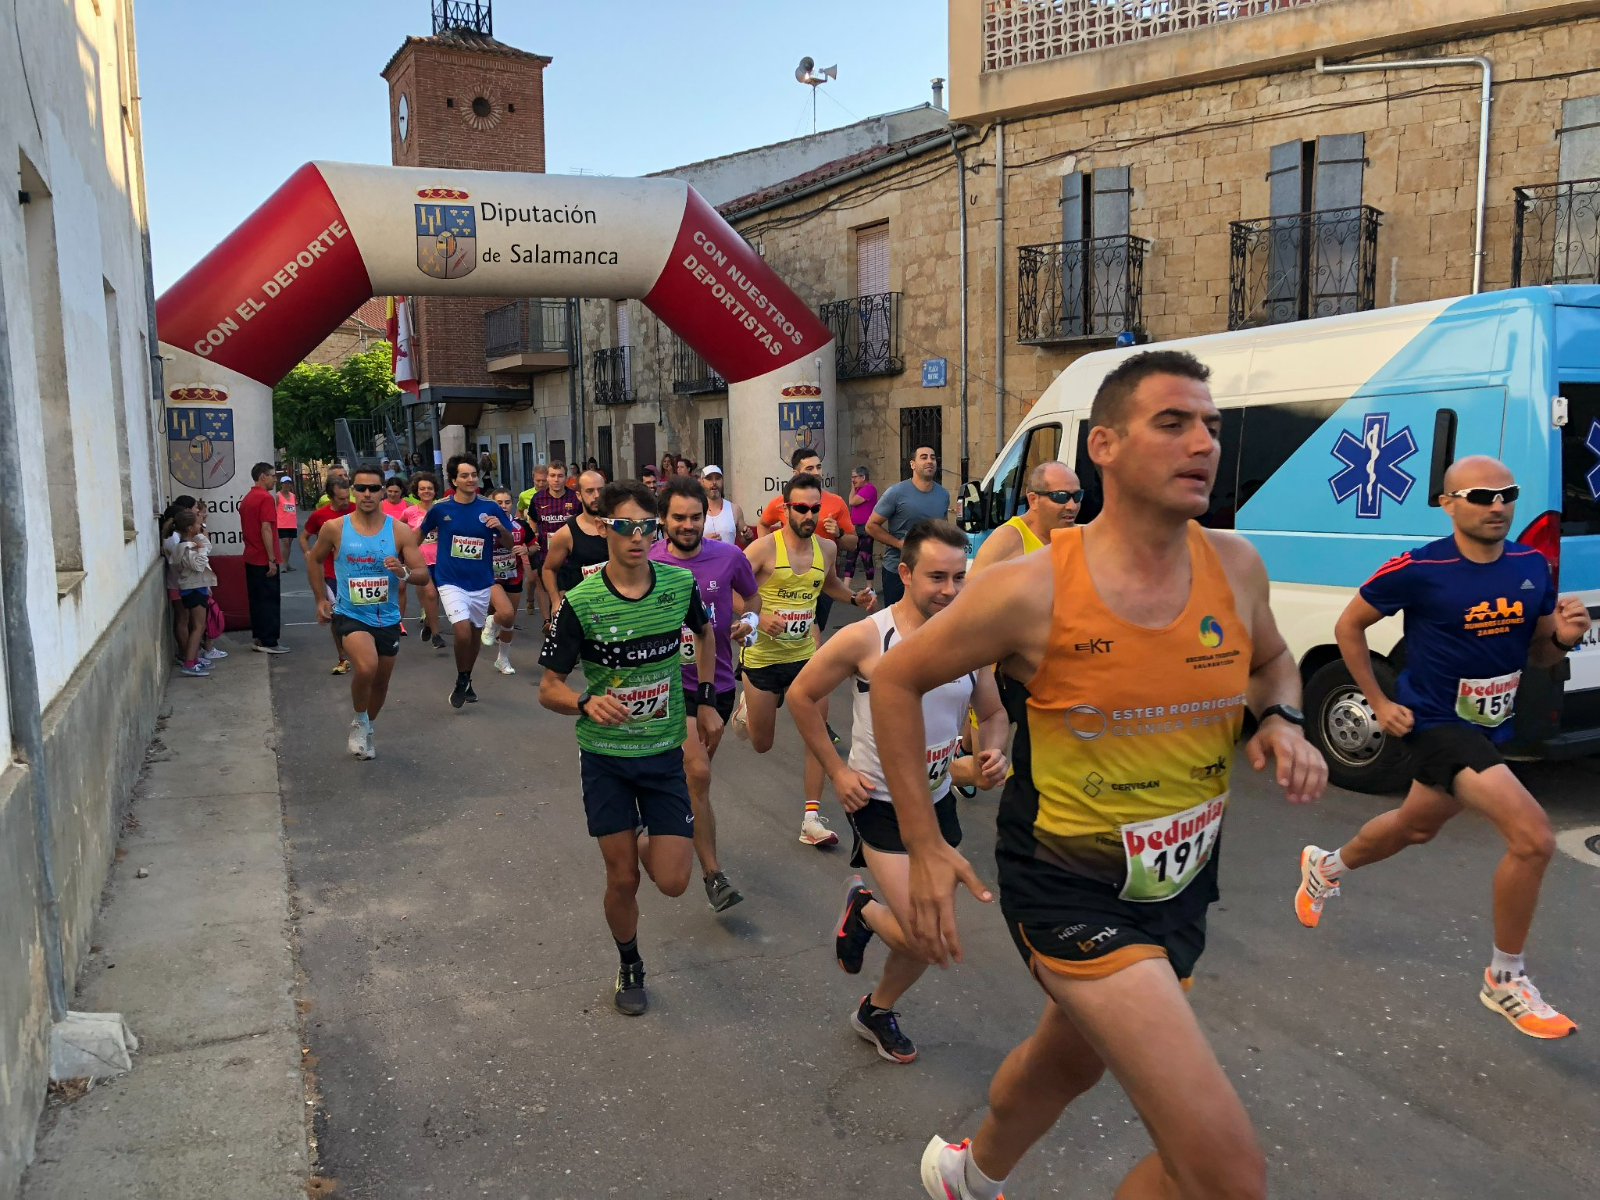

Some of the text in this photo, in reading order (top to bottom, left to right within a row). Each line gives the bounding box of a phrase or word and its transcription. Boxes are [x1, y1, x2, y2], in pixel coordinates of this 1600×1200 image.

[480, 202, 597, 227] Diputación
[482, 244, 618, 265] de Salamanca
[194, 219, 348, 356] CON EL DEPORTE
[693, 230, 804, 345] CON NUESTROS
[682, 254, 783, 356] DEPORTISTAS
[459, 544, 477, 554] 146
[349, 579, 389, 588] bedunia
[358, 587, 381, 598] 156
[626, 638, 679, 660] CHARRA
[1075, 638, 1114, 654] EKT
[620, 696, 659, 716] 27
[1112, 706, 1165, 720] ESTER
[1112, 781, 1160, 791] CERVISAN
[1126, 801, 1222, 857] bedunia
[1154, 831, 1205, 882] 191
